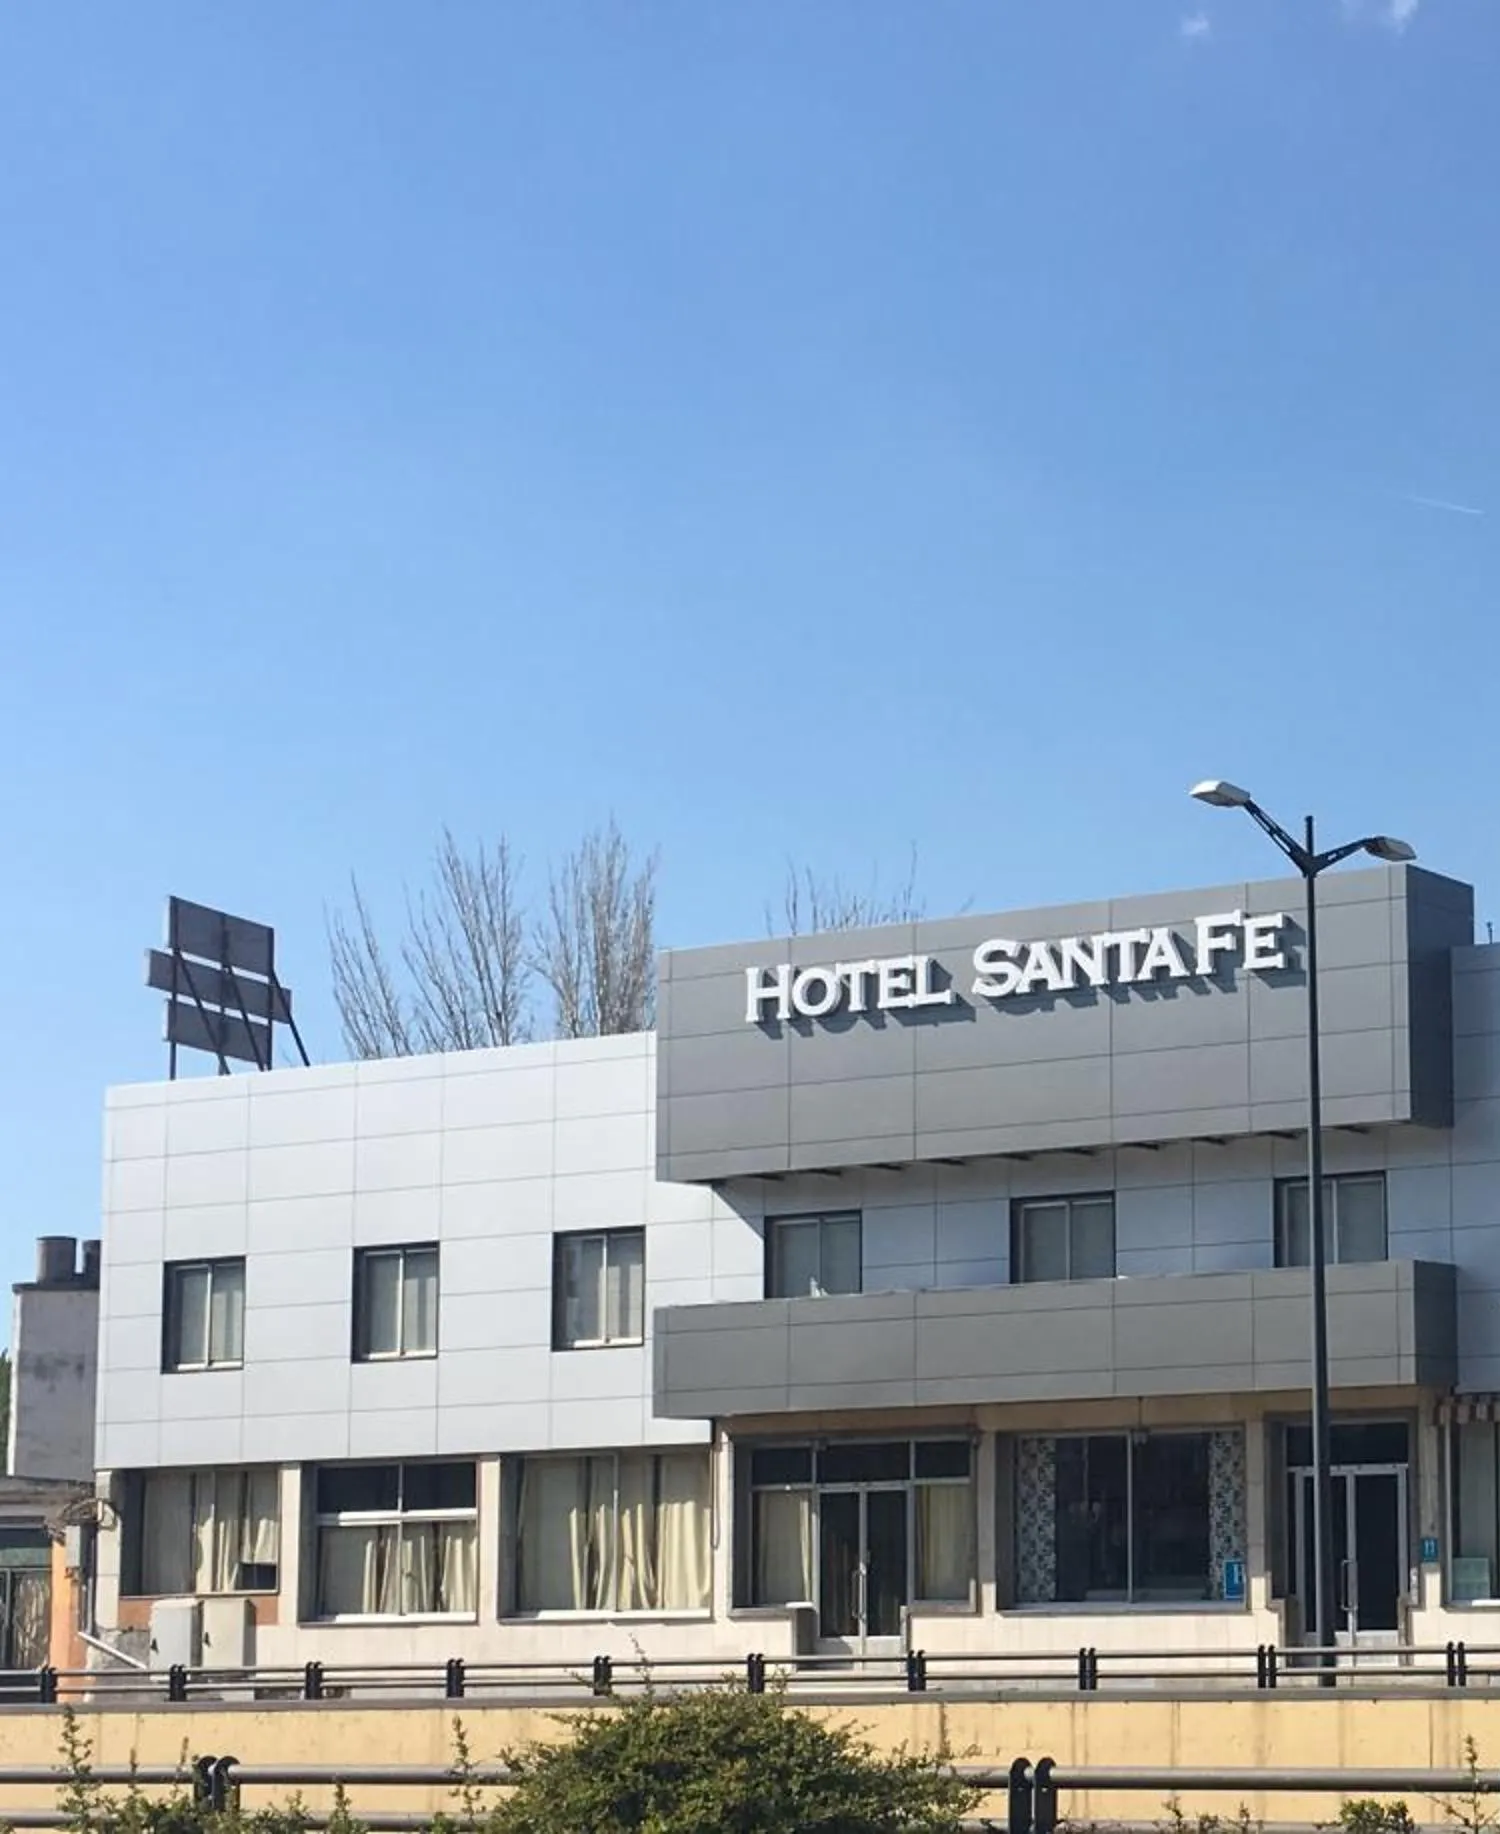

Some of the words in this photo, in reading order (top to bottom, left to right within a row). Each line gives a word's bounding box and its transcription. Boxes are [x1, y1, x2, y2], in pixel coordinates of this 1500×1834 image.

[745, 955, 952, 1024] HOTEL
[971, 927, 1190, 998] SANTA
[1194, 908, 1285, 976] FE
